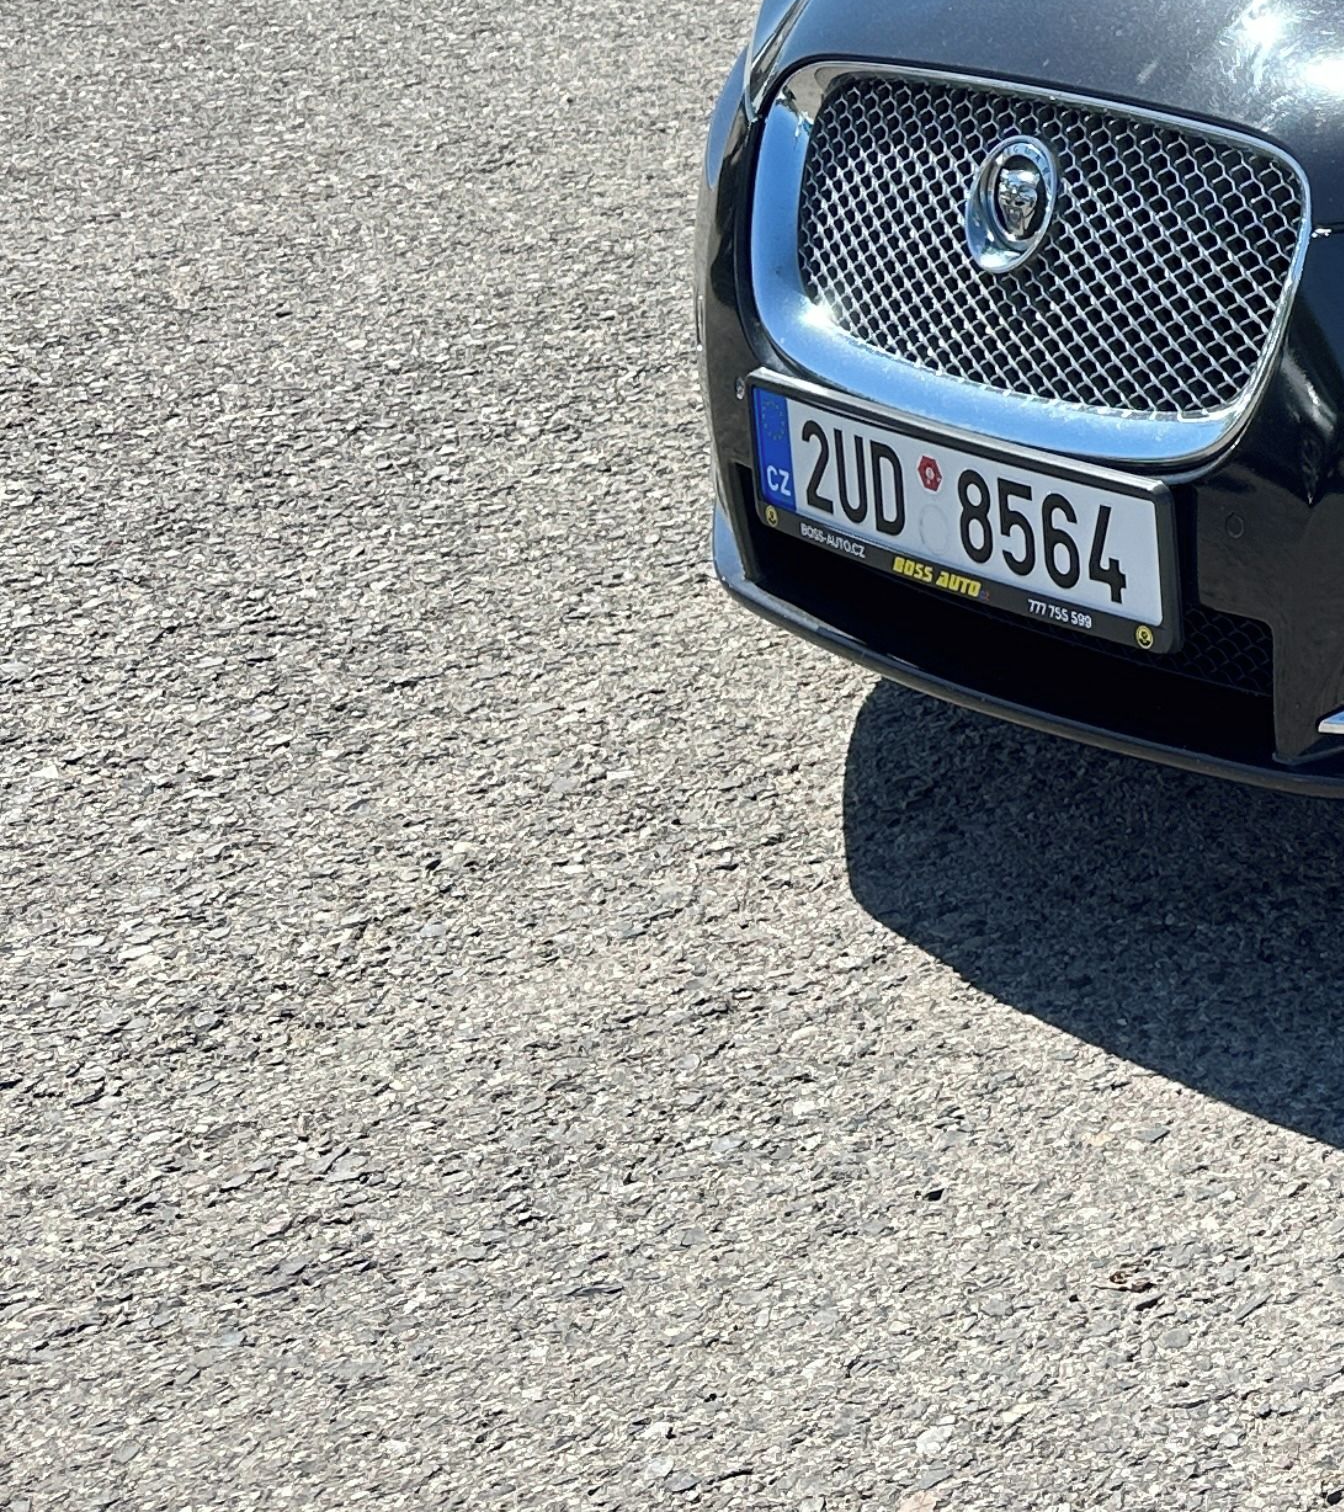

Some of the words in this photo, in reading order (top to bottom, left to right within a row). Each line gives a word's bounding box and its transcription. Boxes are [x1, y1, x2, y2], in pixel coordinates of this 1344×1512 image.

[765, 464, 792, 498] CZ
[801, 419, 906, 537] 2UD
[957, 468, 1128, 605] 8564
[800, 521, 866, 559] BOSS-AUTO.CZ
[892, 555, 934, 584] BOSS
[935, 572, 982, 598] AUTO
[1027, 597, 1047, 616] 777
[1047, 603, 1070, 623] 755
